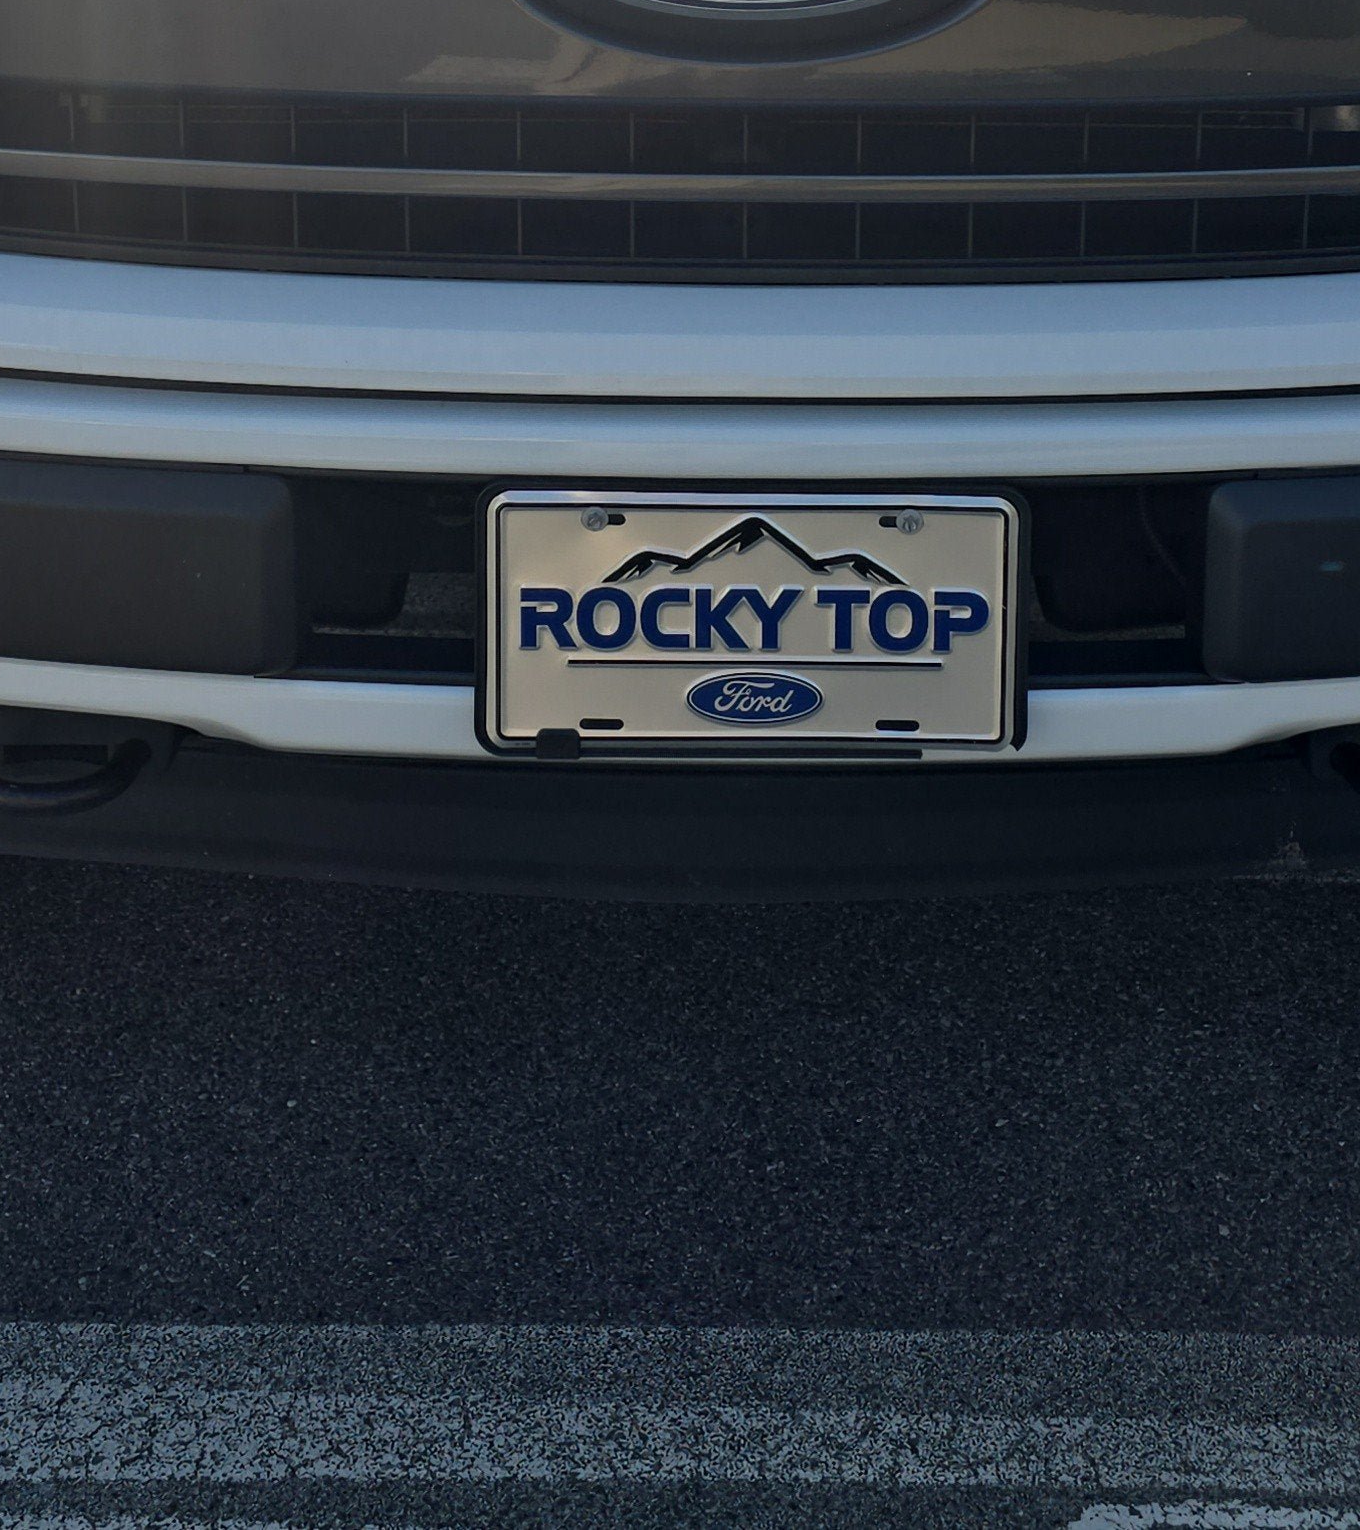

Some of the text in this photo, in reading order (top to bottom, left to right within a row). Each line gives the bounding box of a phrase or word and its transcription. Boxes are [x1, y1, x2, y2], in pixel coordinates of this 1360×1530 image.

[519, 585, 991, 654] ROCKY TOP
[713, 679, 796, 716] Ford
